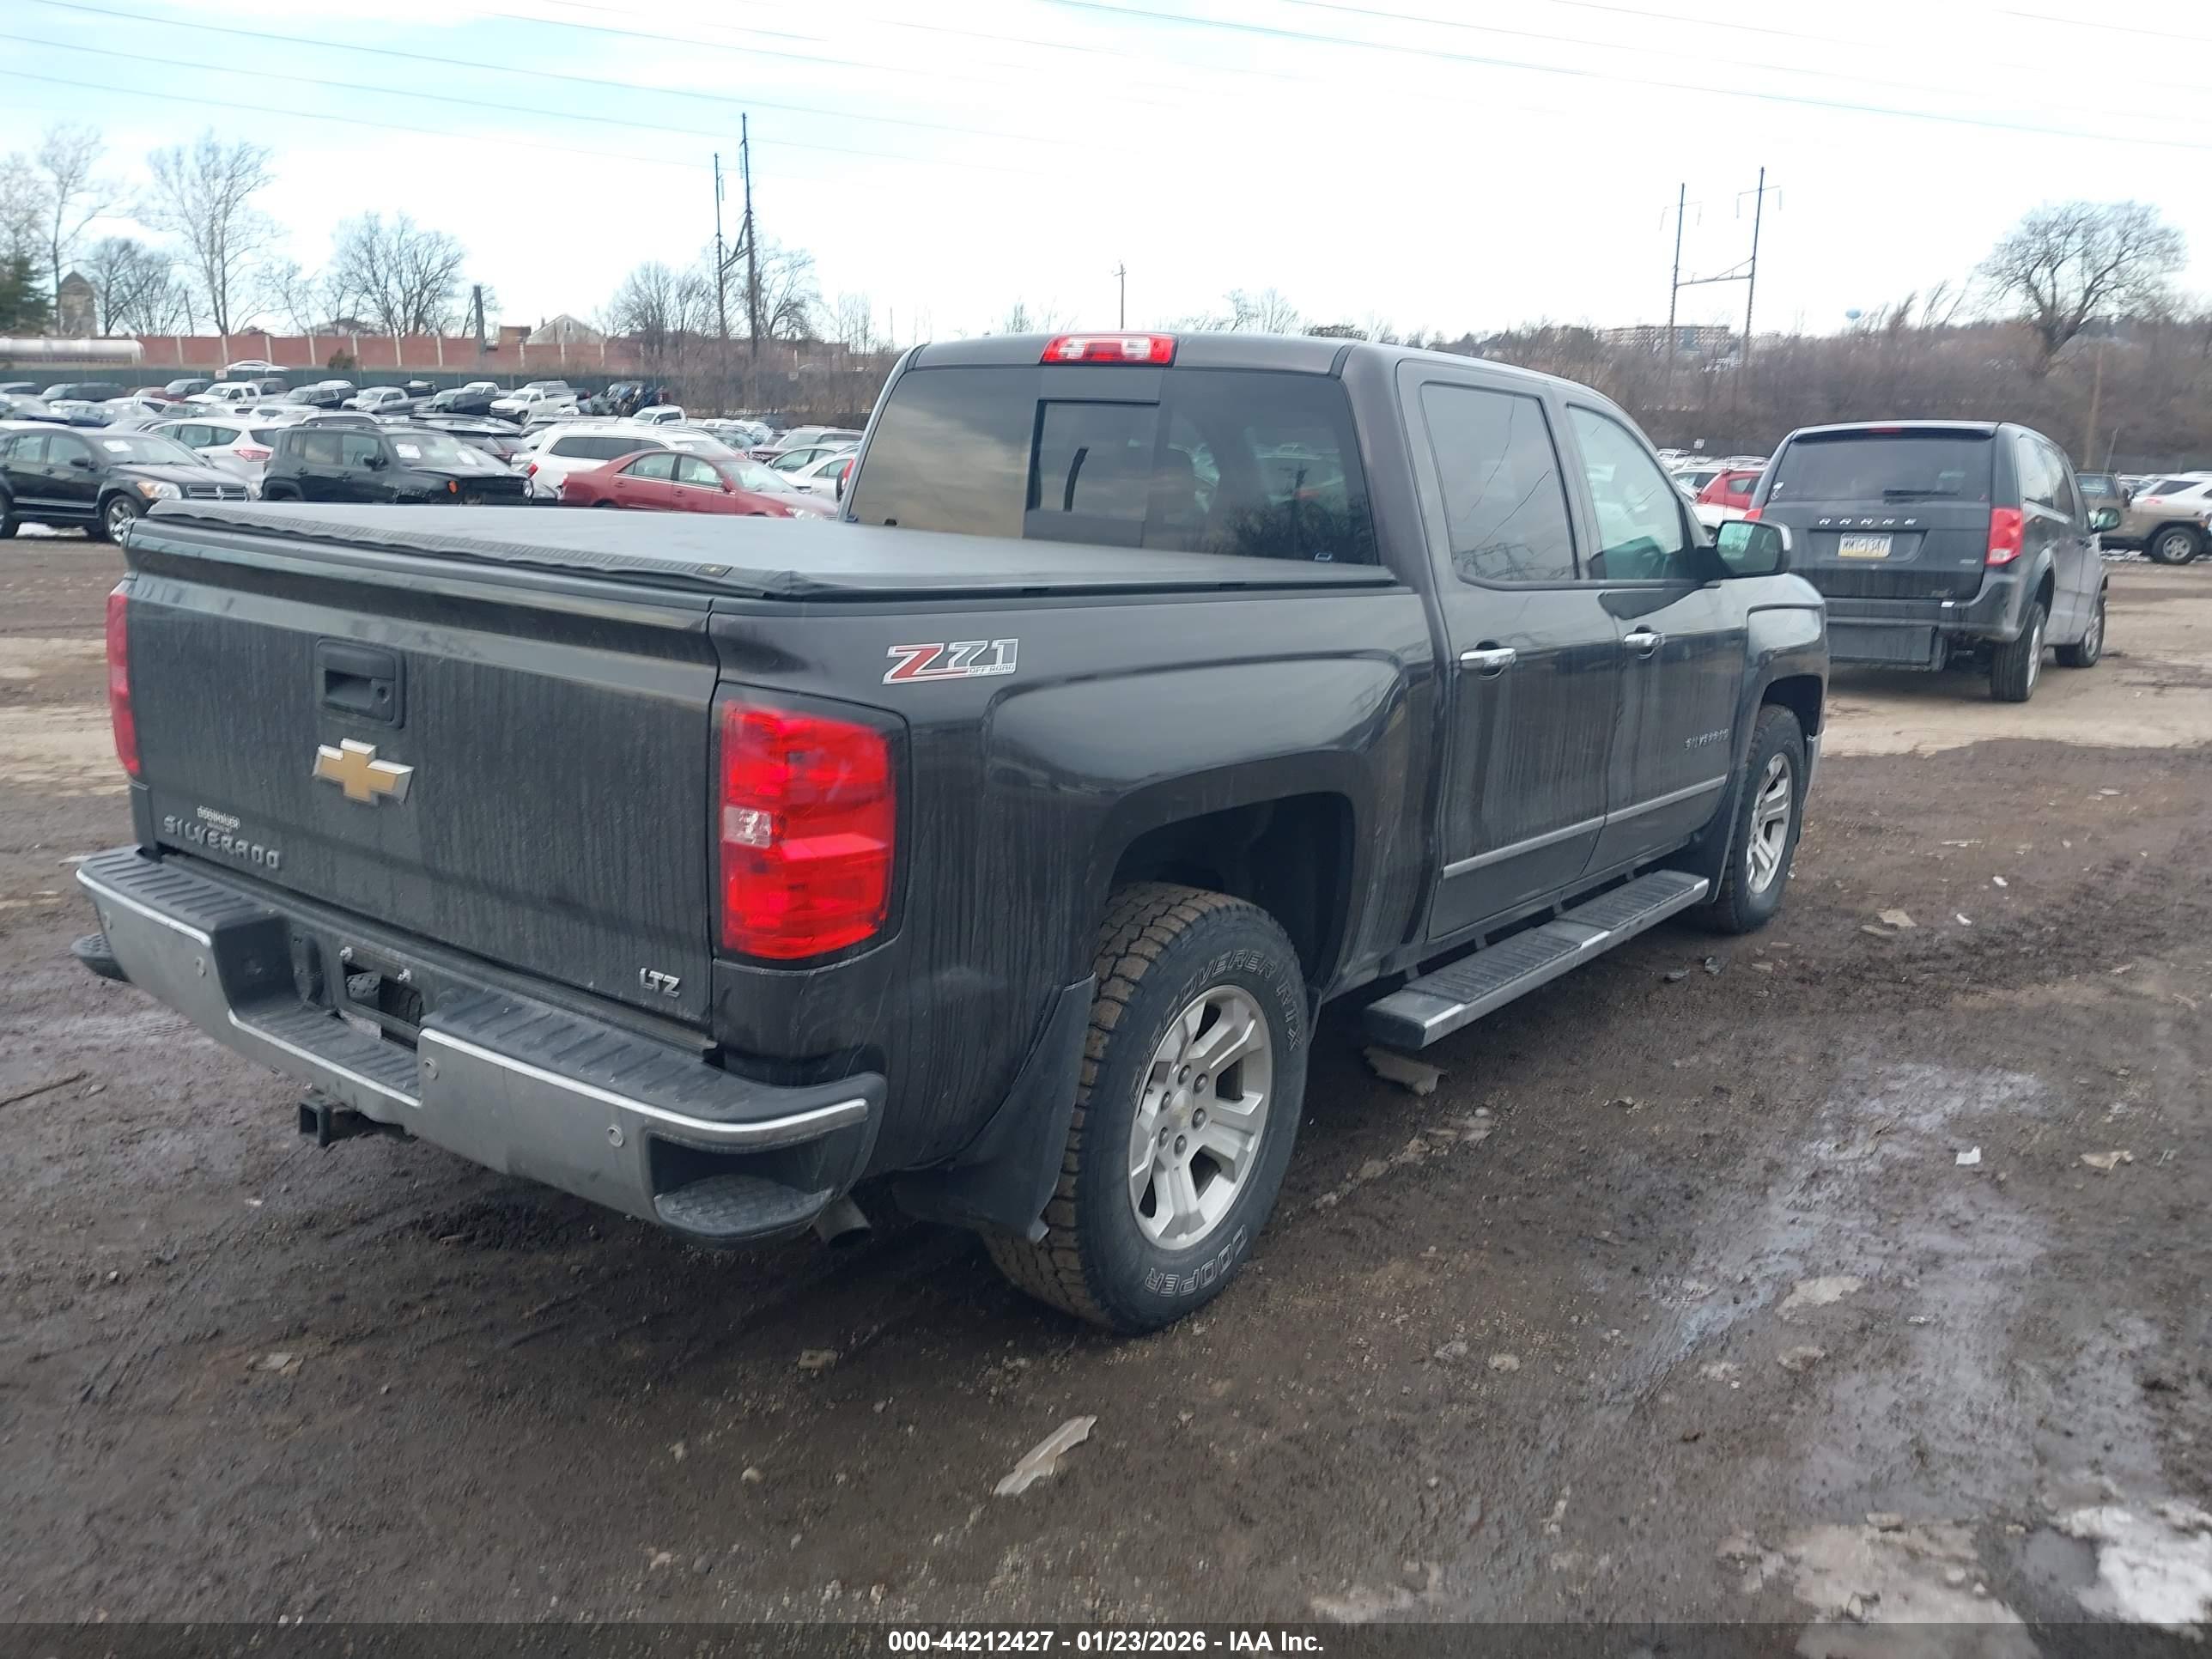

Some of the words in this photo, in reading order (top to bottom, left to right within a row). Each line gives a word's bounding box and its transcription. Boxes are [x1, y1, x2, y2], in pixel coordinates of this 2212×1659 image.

[882, 638, 1018, 684] Z71
[163, 815, 280, 869] SILVERADO
[639, 968, 680, 998] LTZ
[1145, 1224, 1247, 1297] COOPER
